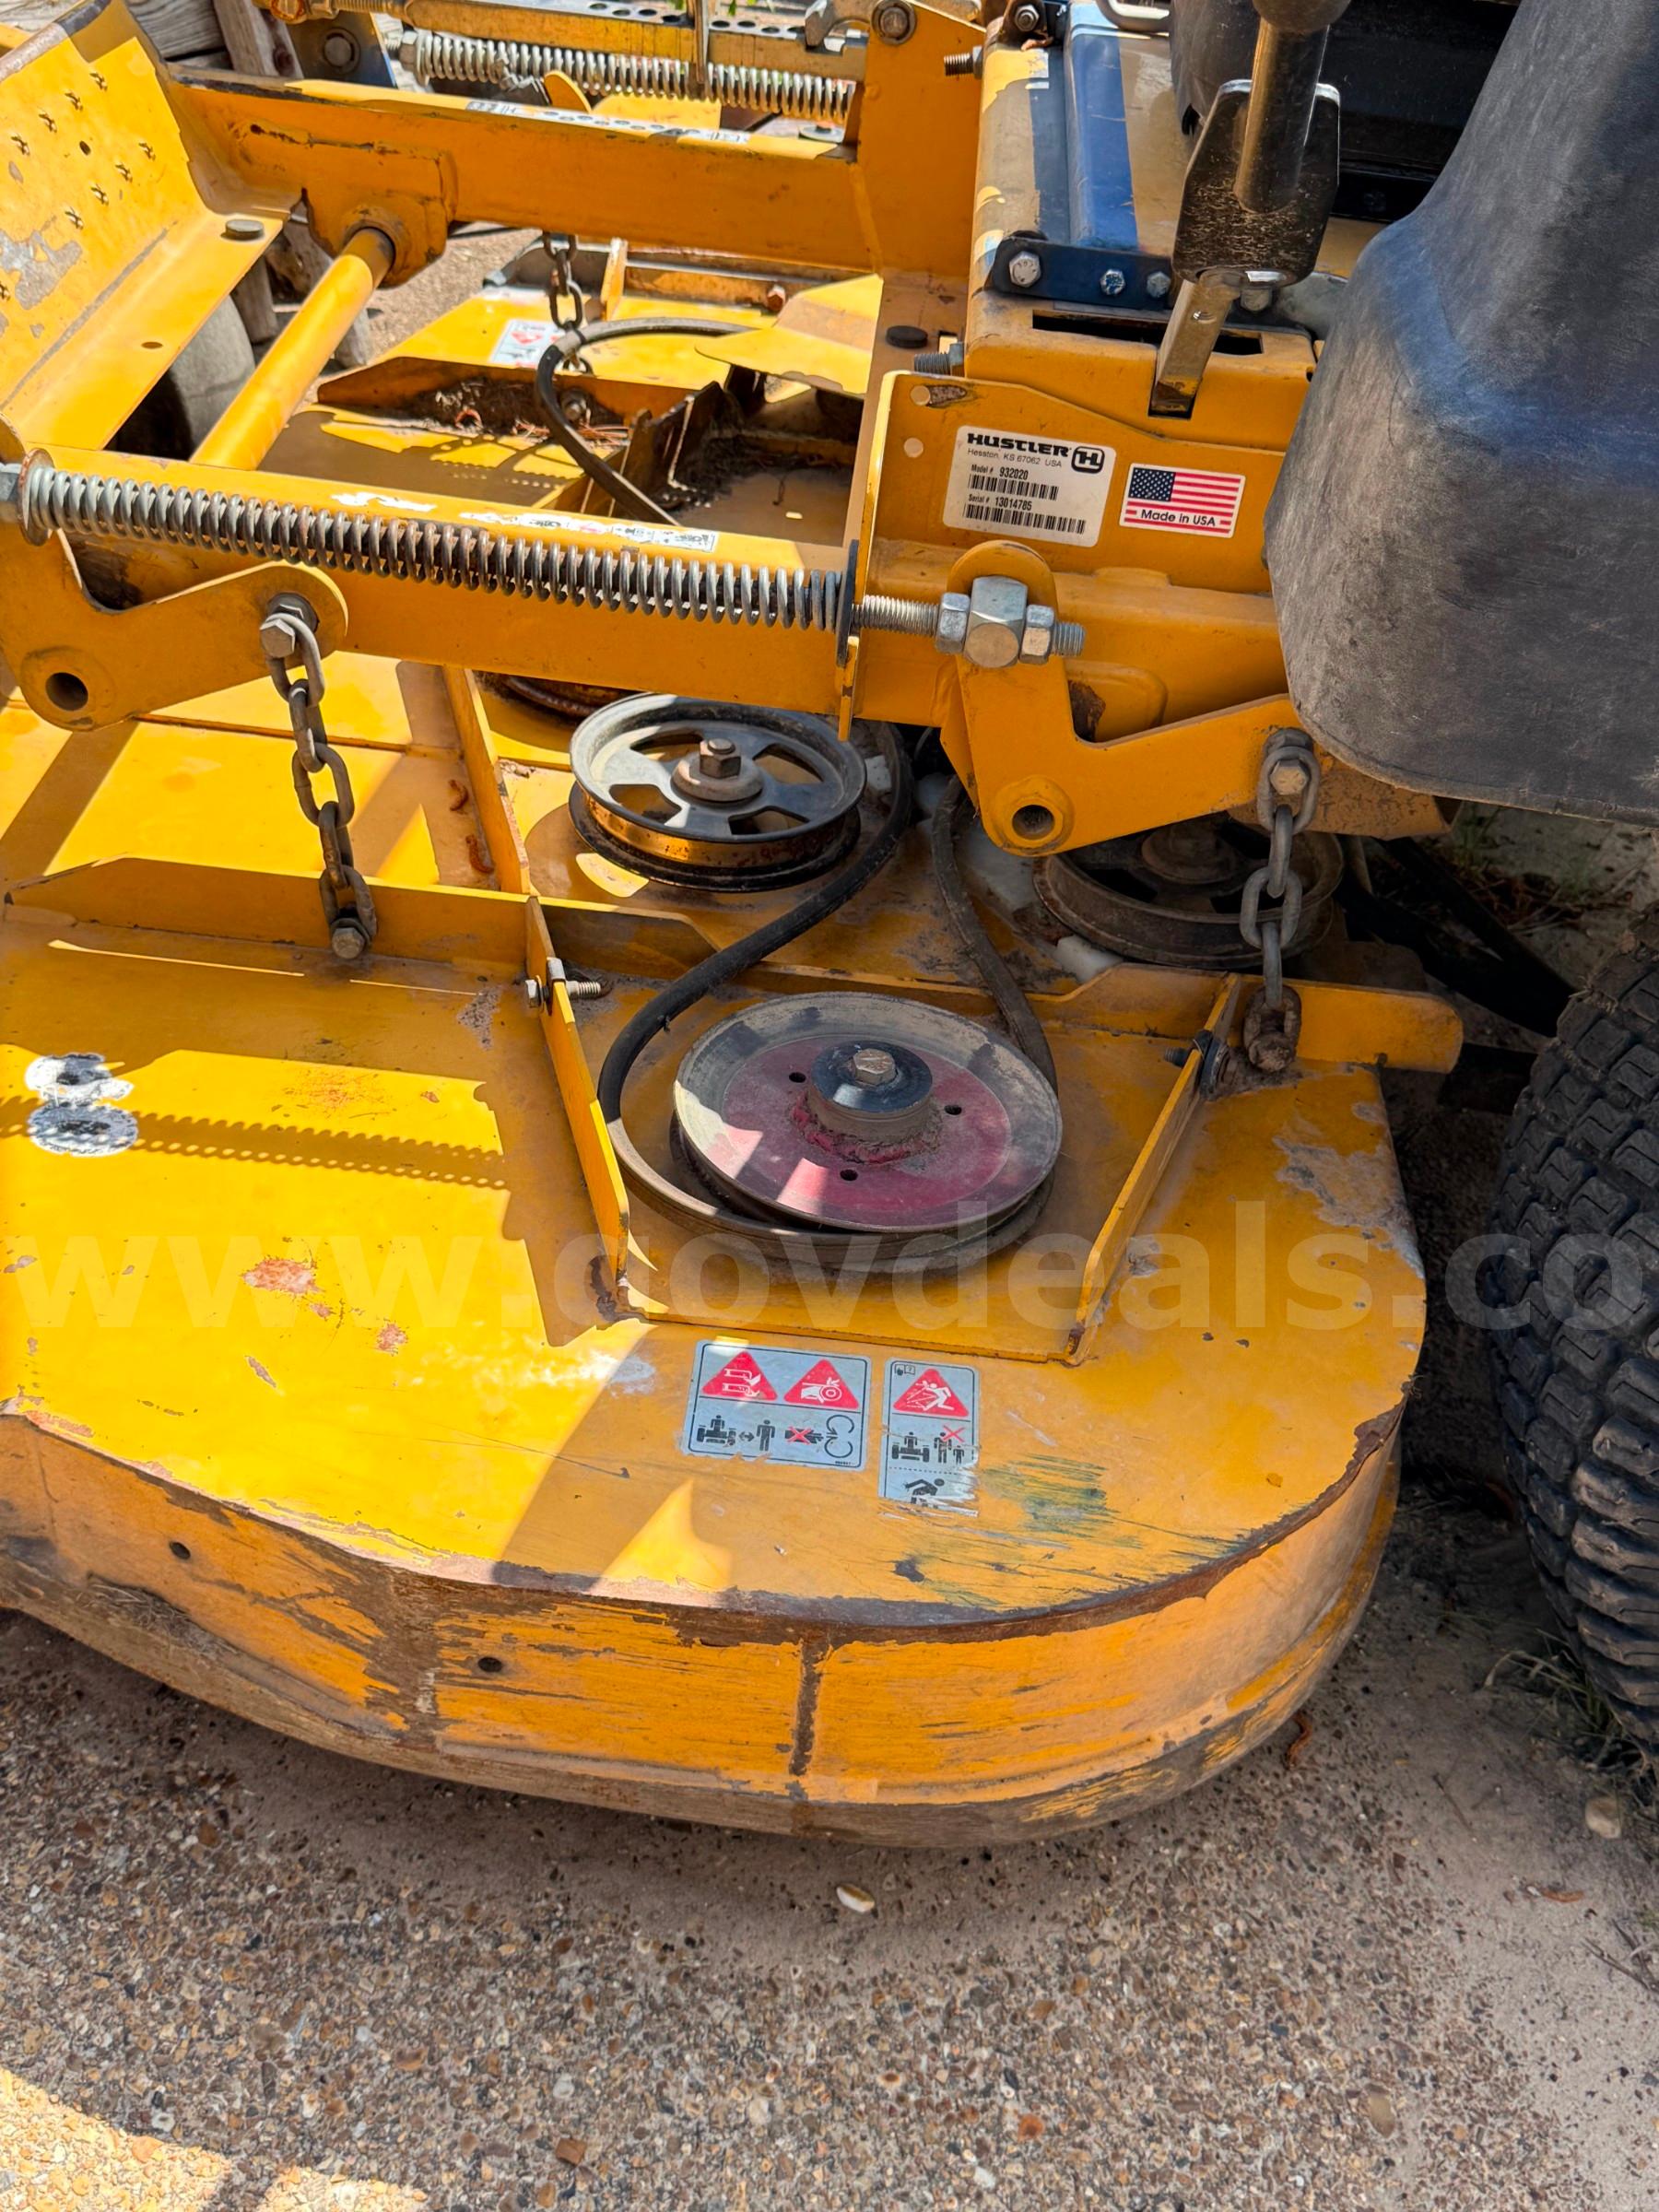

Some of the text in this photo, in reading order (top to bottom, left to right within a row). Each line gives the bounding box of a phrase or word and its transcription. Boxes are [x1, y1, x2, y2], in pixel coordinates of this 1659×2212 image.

[968, 433, 1069, 457] HUSTLER
[1003, 453, 1016, 462] KS
[1017, 454, 1041, 465] 67062
[1045, 459, 1062, 467] USA
[971, 464, 988, 473] Model
[999, 466, 1029, 480] 932020
[968, 494, 984, 503] Serial
[1141, 509, 1216, 526] Made in USA
